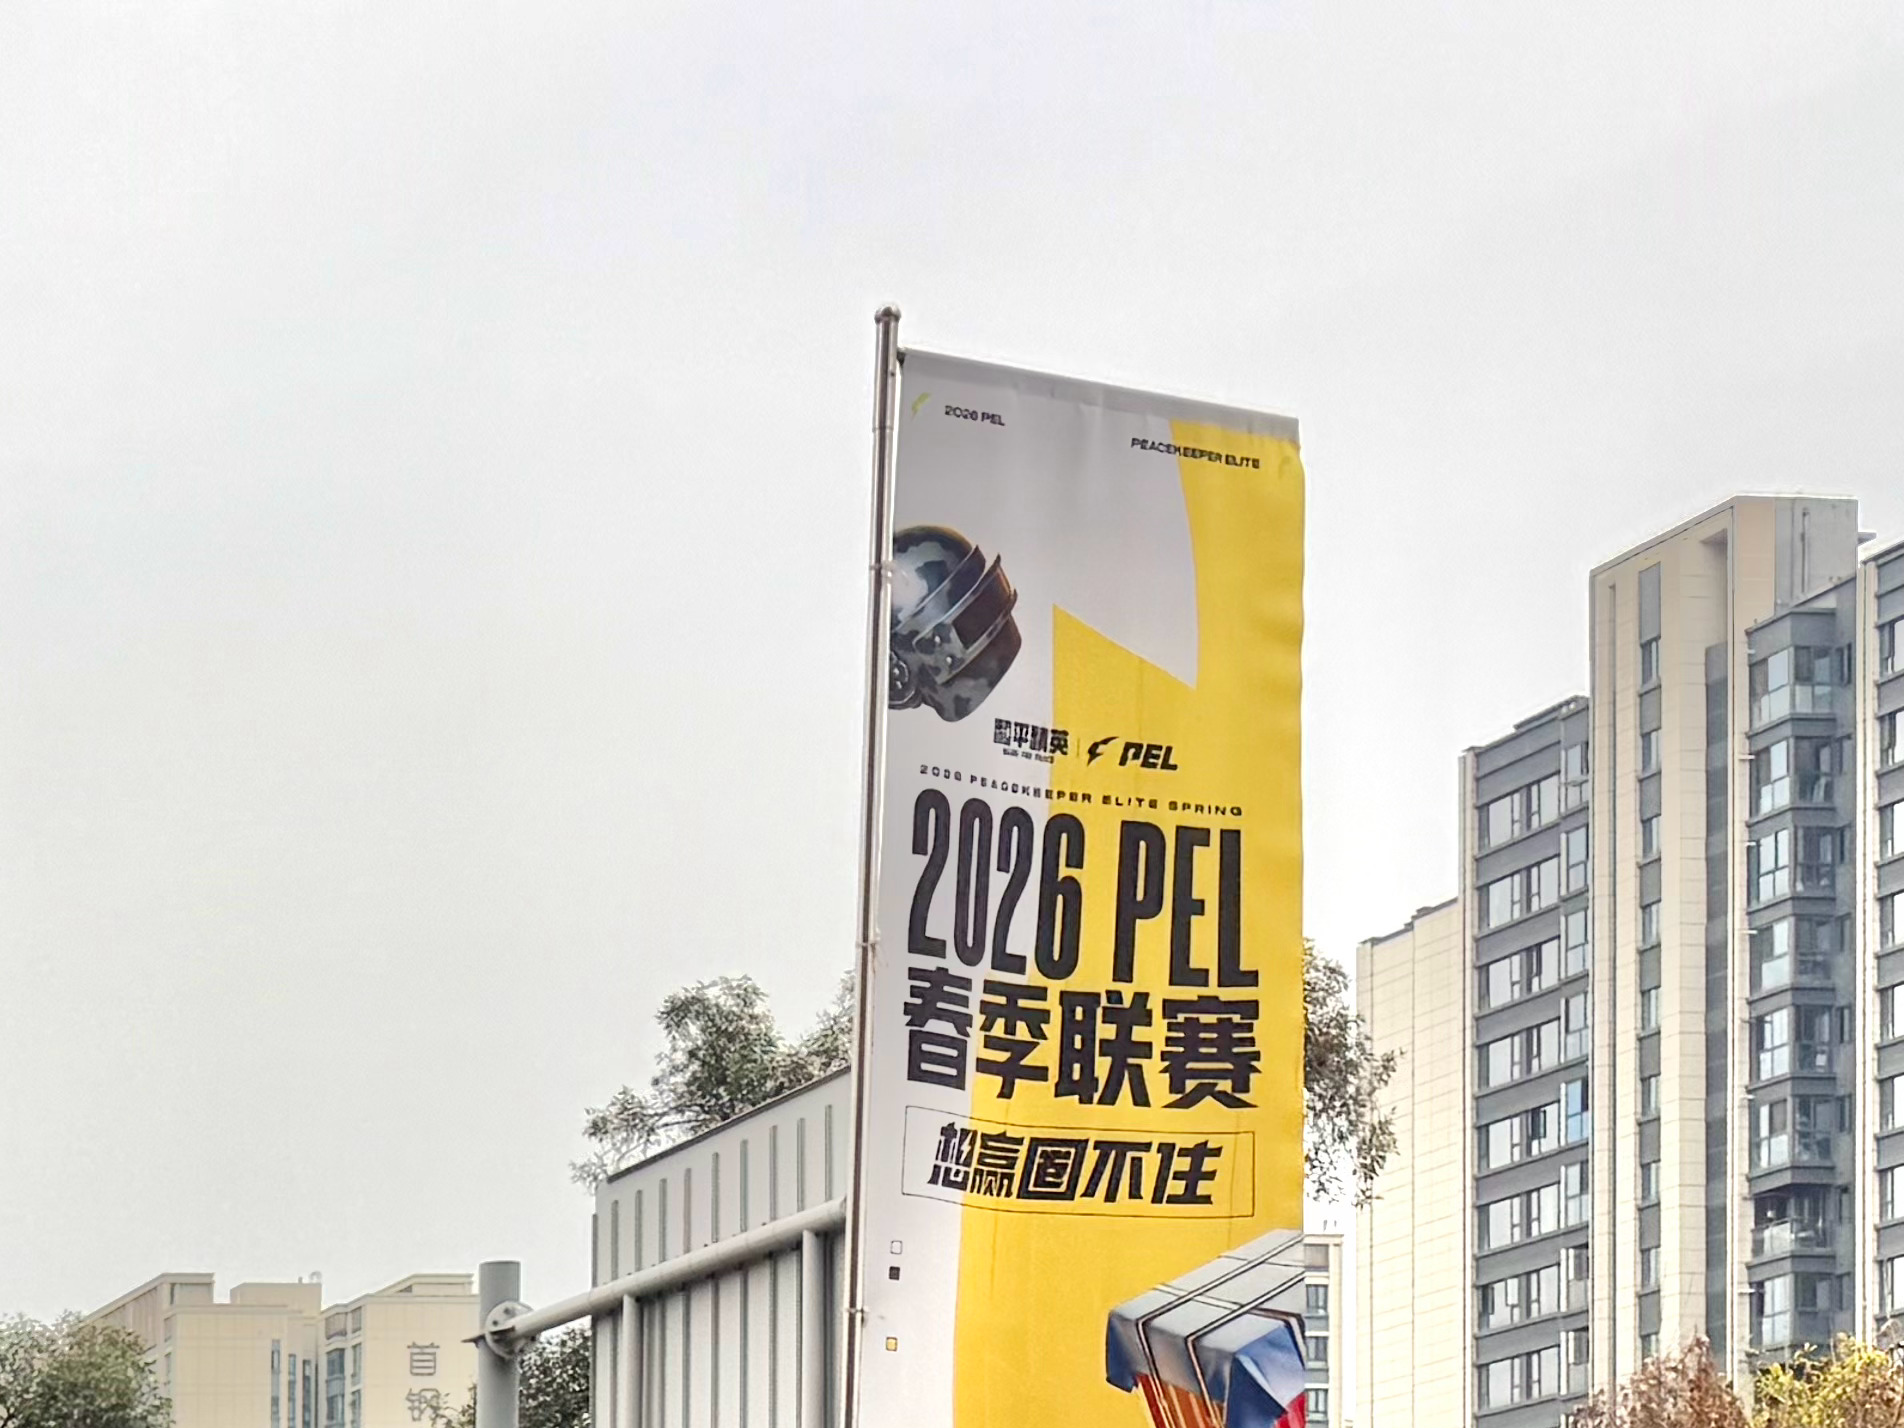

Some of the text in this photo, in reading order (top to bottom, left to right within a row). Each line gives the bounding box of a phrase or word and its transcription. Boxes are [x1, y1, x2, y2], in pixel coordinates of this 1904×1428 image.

[1117, 740, 1179, 771] PEL
[1101, 794, 1158, 809] ELITE
[1167, 800, 1243, 817] SPRING
[907, 787, 1260, 989] 2026 PEL
[903, 966, 1262, 1110] 春季联赛
